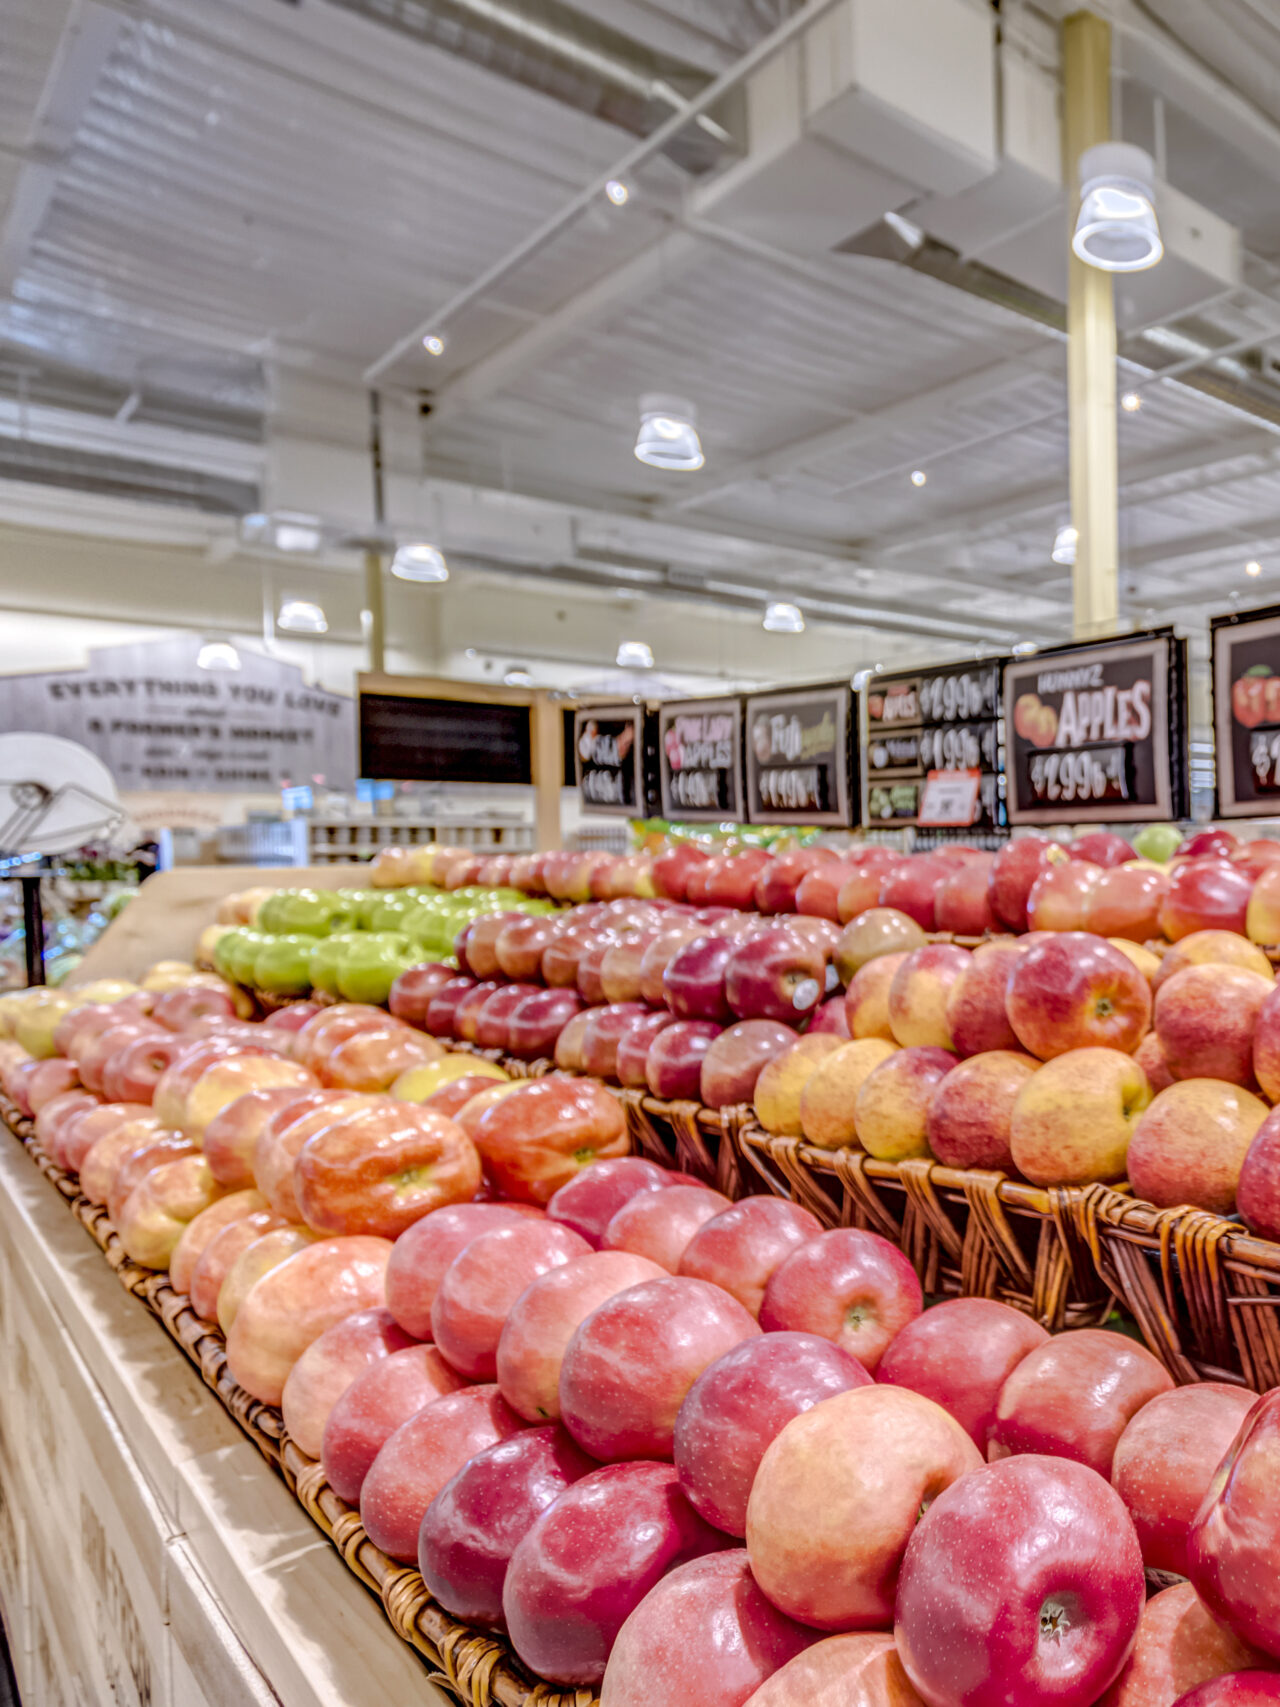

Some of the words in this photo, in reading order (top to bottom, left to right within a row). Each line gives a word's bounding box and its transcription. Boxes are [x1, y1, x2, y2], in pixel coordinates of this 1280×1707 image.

[48, 677, 218, 700] EVERYTHING
[229, 683, 275, 706] YOU
[284, 690, 341, 717] LOVE
[1054, 679, 1151, 748] APPLES
